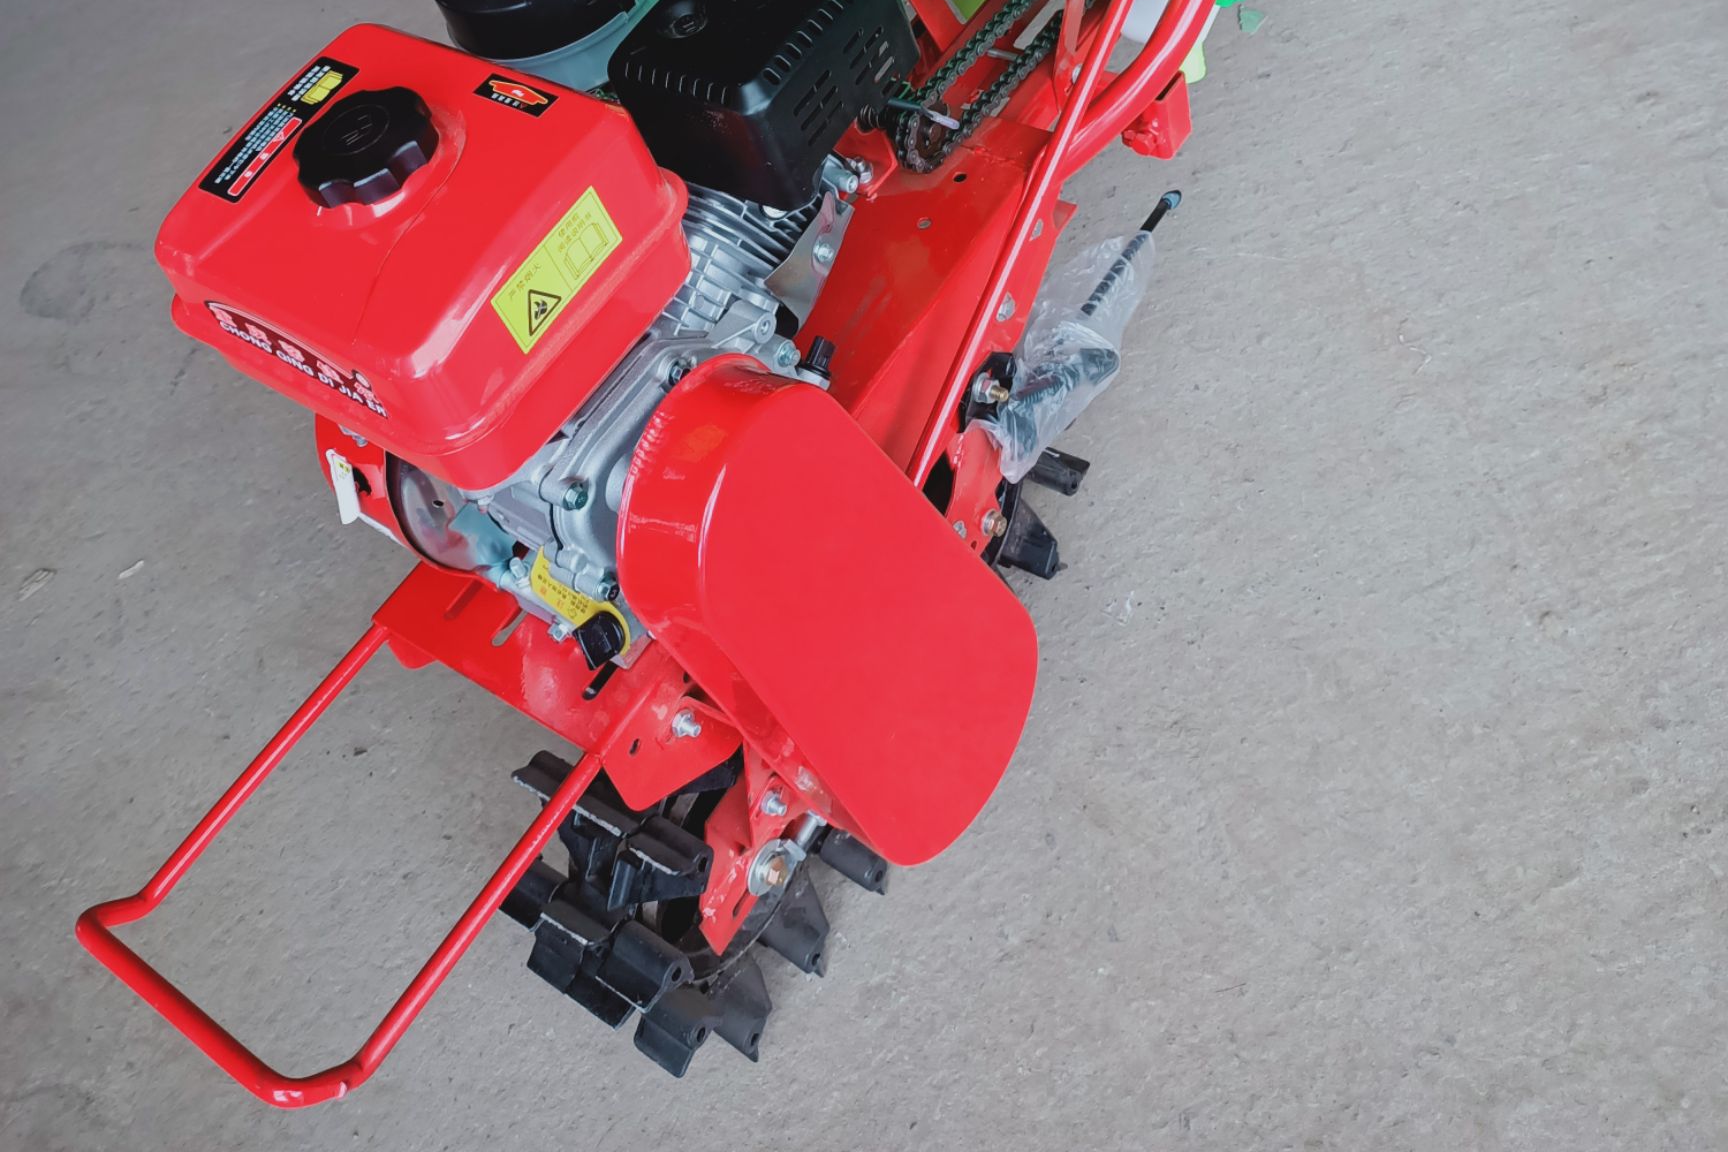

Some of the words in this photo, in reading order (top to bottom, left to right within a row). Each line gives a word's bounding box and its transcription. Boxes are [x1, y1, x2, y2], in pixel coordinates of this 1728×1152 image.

[219, 321, 272, 353] CHONG
[276, 350, 314, 376] QING
[318, 372, 335, 388] DI
[338, 385, 364, 404] JIA
[367, 400, 388, 418] ER
